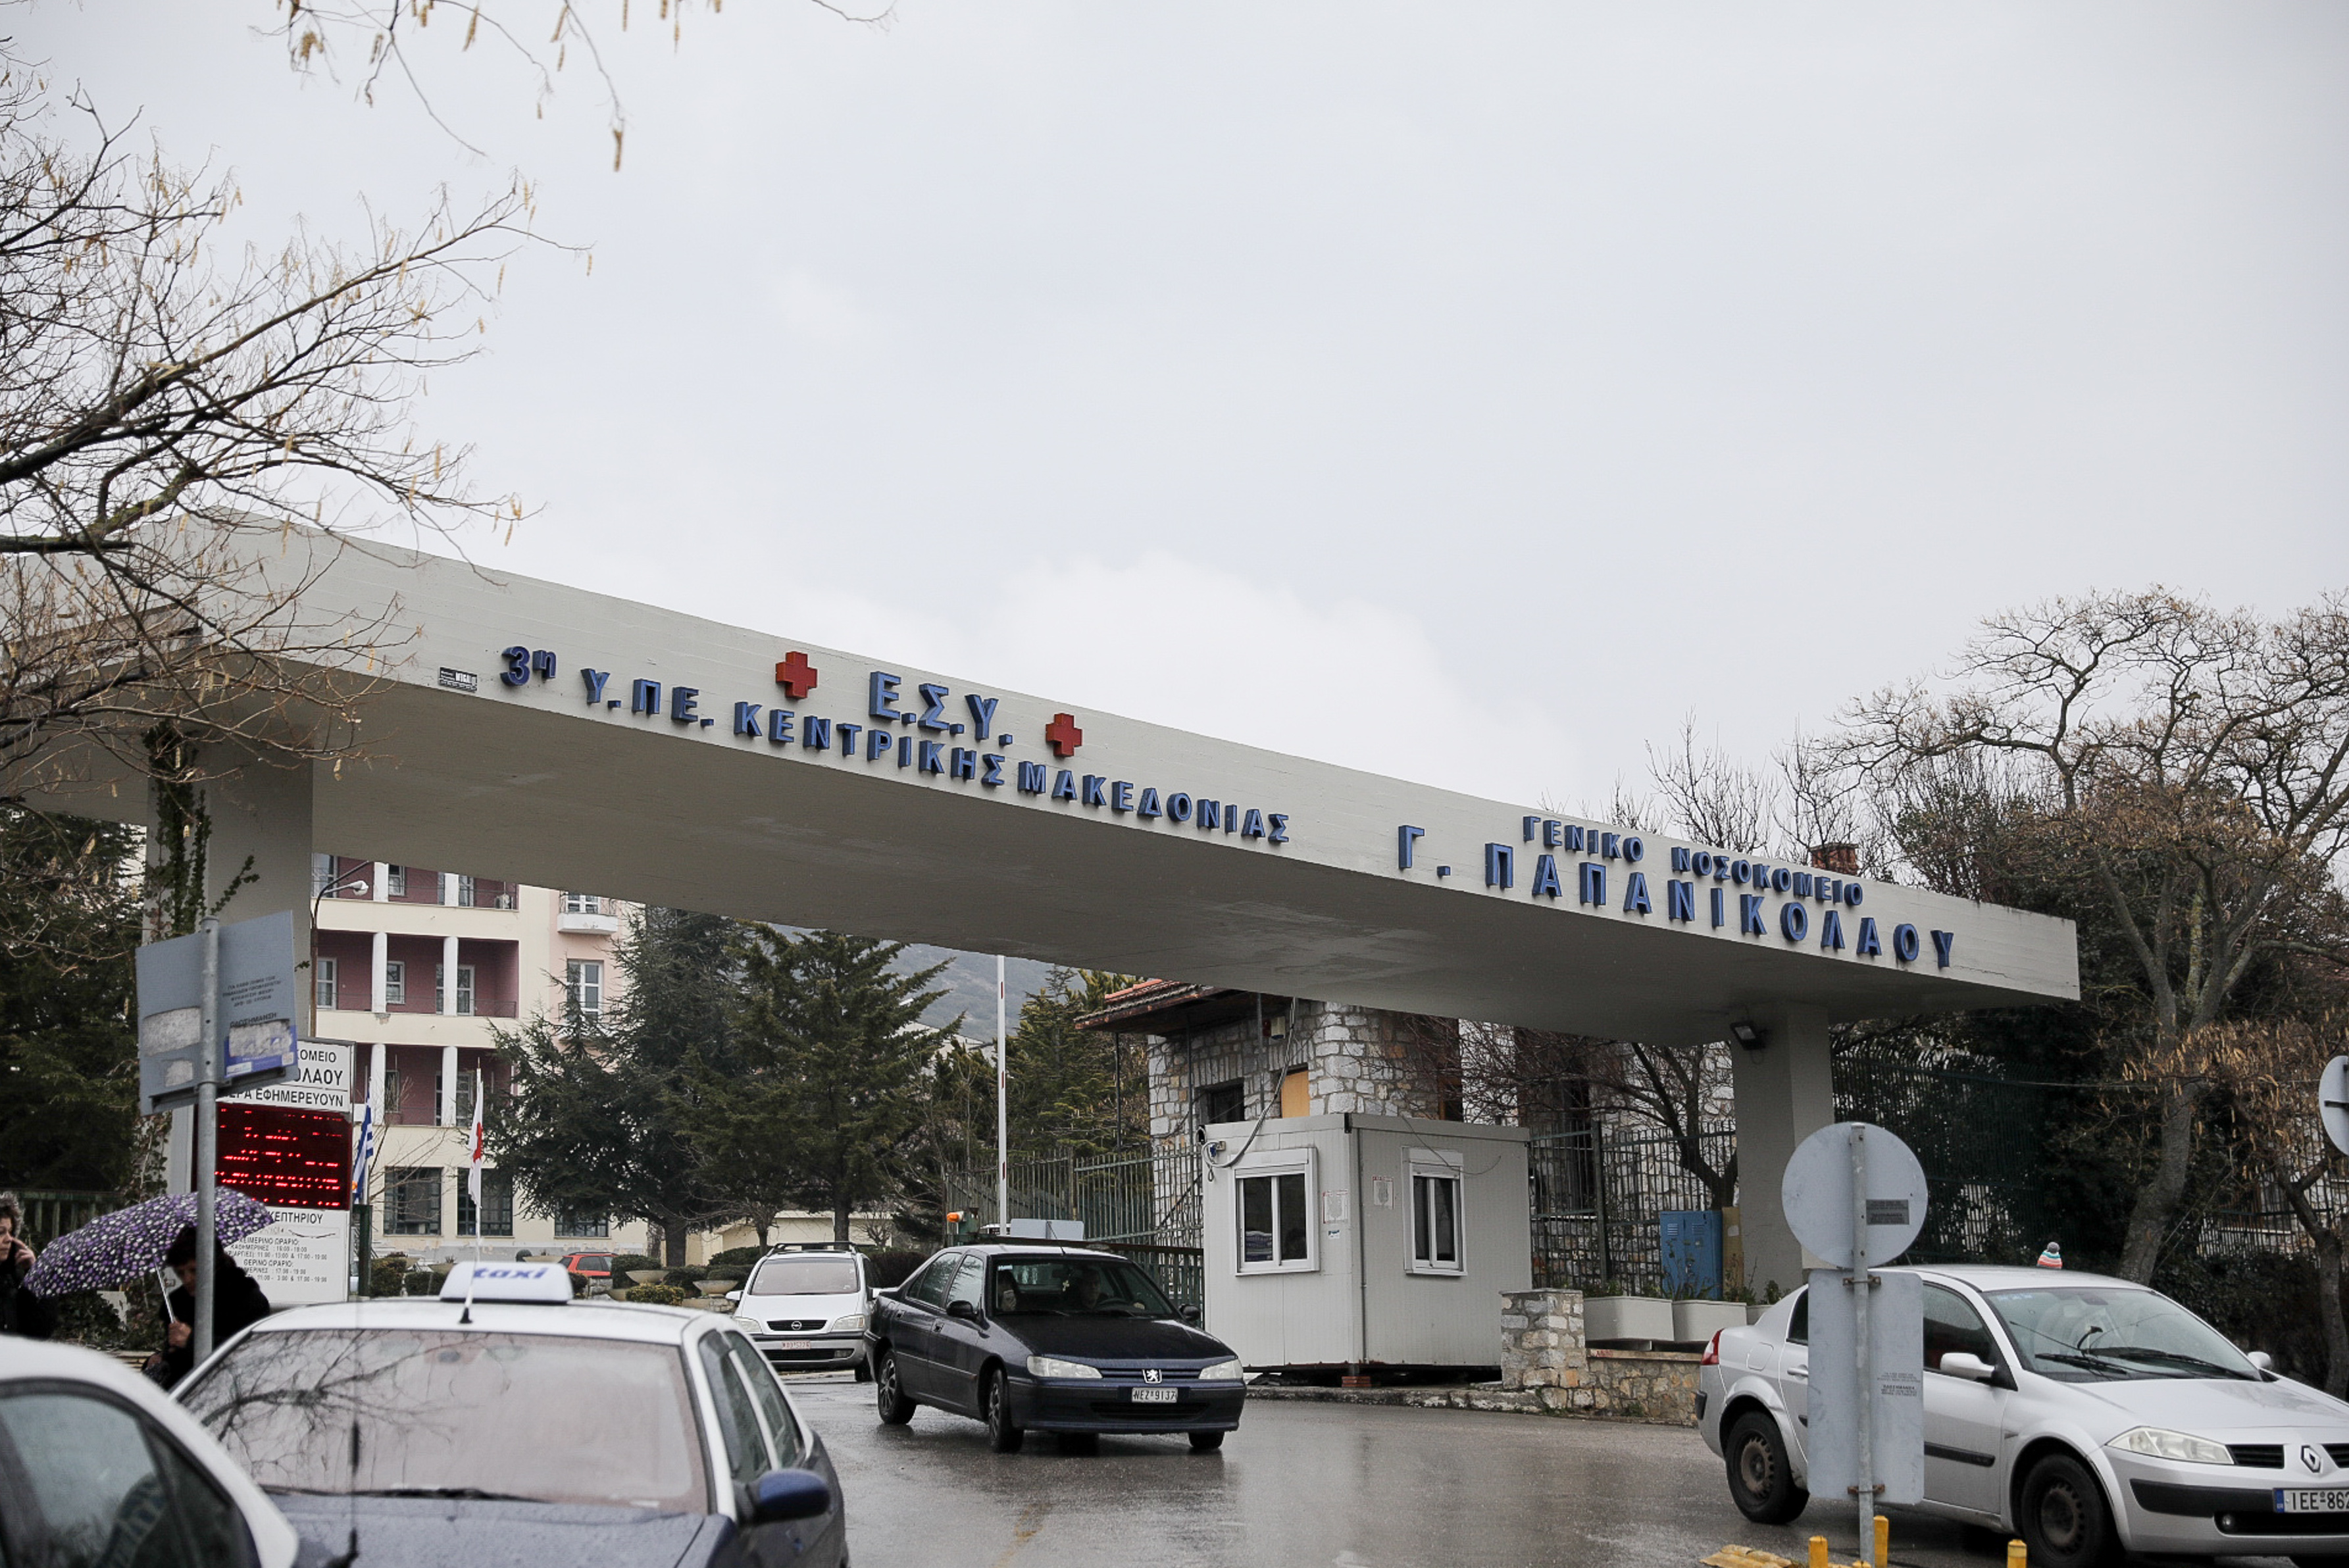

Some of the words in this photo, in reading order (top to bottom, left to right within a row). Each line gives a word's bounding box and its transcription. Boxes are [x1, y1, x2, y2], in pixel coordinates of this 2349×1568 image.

[869, 671, 1013, 745] Ε.Σ.Υ.
[580, 668, 714, 726] Υ.ΠΕ.
[734, 701, 1005, 786] ΚΕΝΤΡΙΚΗΣ
[1018, 761, 1289, 843] ΜΑΚΕΔΟΝΙΑΣ
[1398, 825, 1451, 876] Γ.
[1485, 843, 1954, 969] ΠΑΠΑΝΙΚΟΛΑΟΥ
[1523, 816, 1644, 863] ΓΕΝΙΚΟ
[1671, 847, 1863, 906] ΝΟΣΟΚΟΜΕΙΟ
[298, 1050, 336, 1063] ΟΜΕΙΟ
[256, 1088, 343, 1107] ΕΦΗΜΕΡΕΥΟΥΝ
[473, 1267, 549, 1279] taxi
